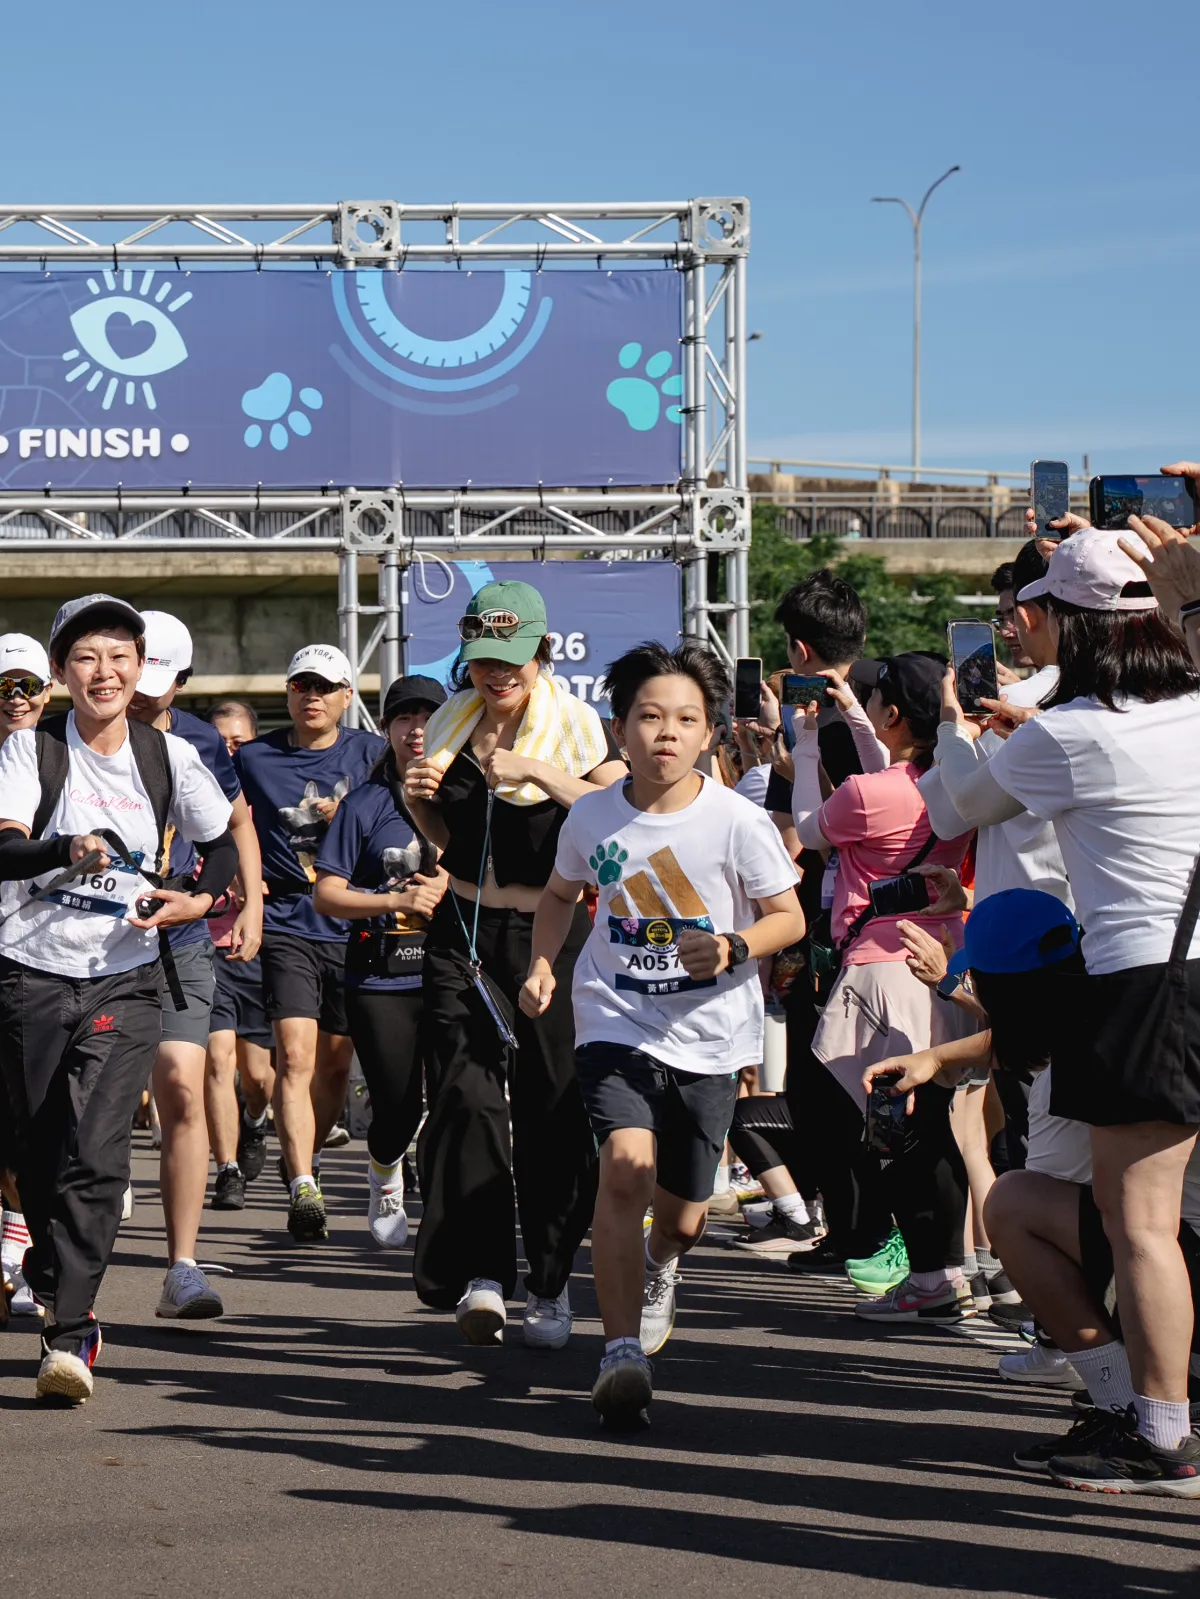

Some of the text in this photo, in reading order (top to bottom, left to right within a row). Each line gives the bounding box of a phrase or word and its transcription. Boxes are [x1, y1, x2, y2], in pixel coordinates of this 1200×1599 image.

[19, 428, 161, 458] FINISH
[314, 648, 335, 662] YORK
[547, 632, 586, 661] 26
[69, 873, 117, 892] 160
[395, 946, 425, 957] AON
